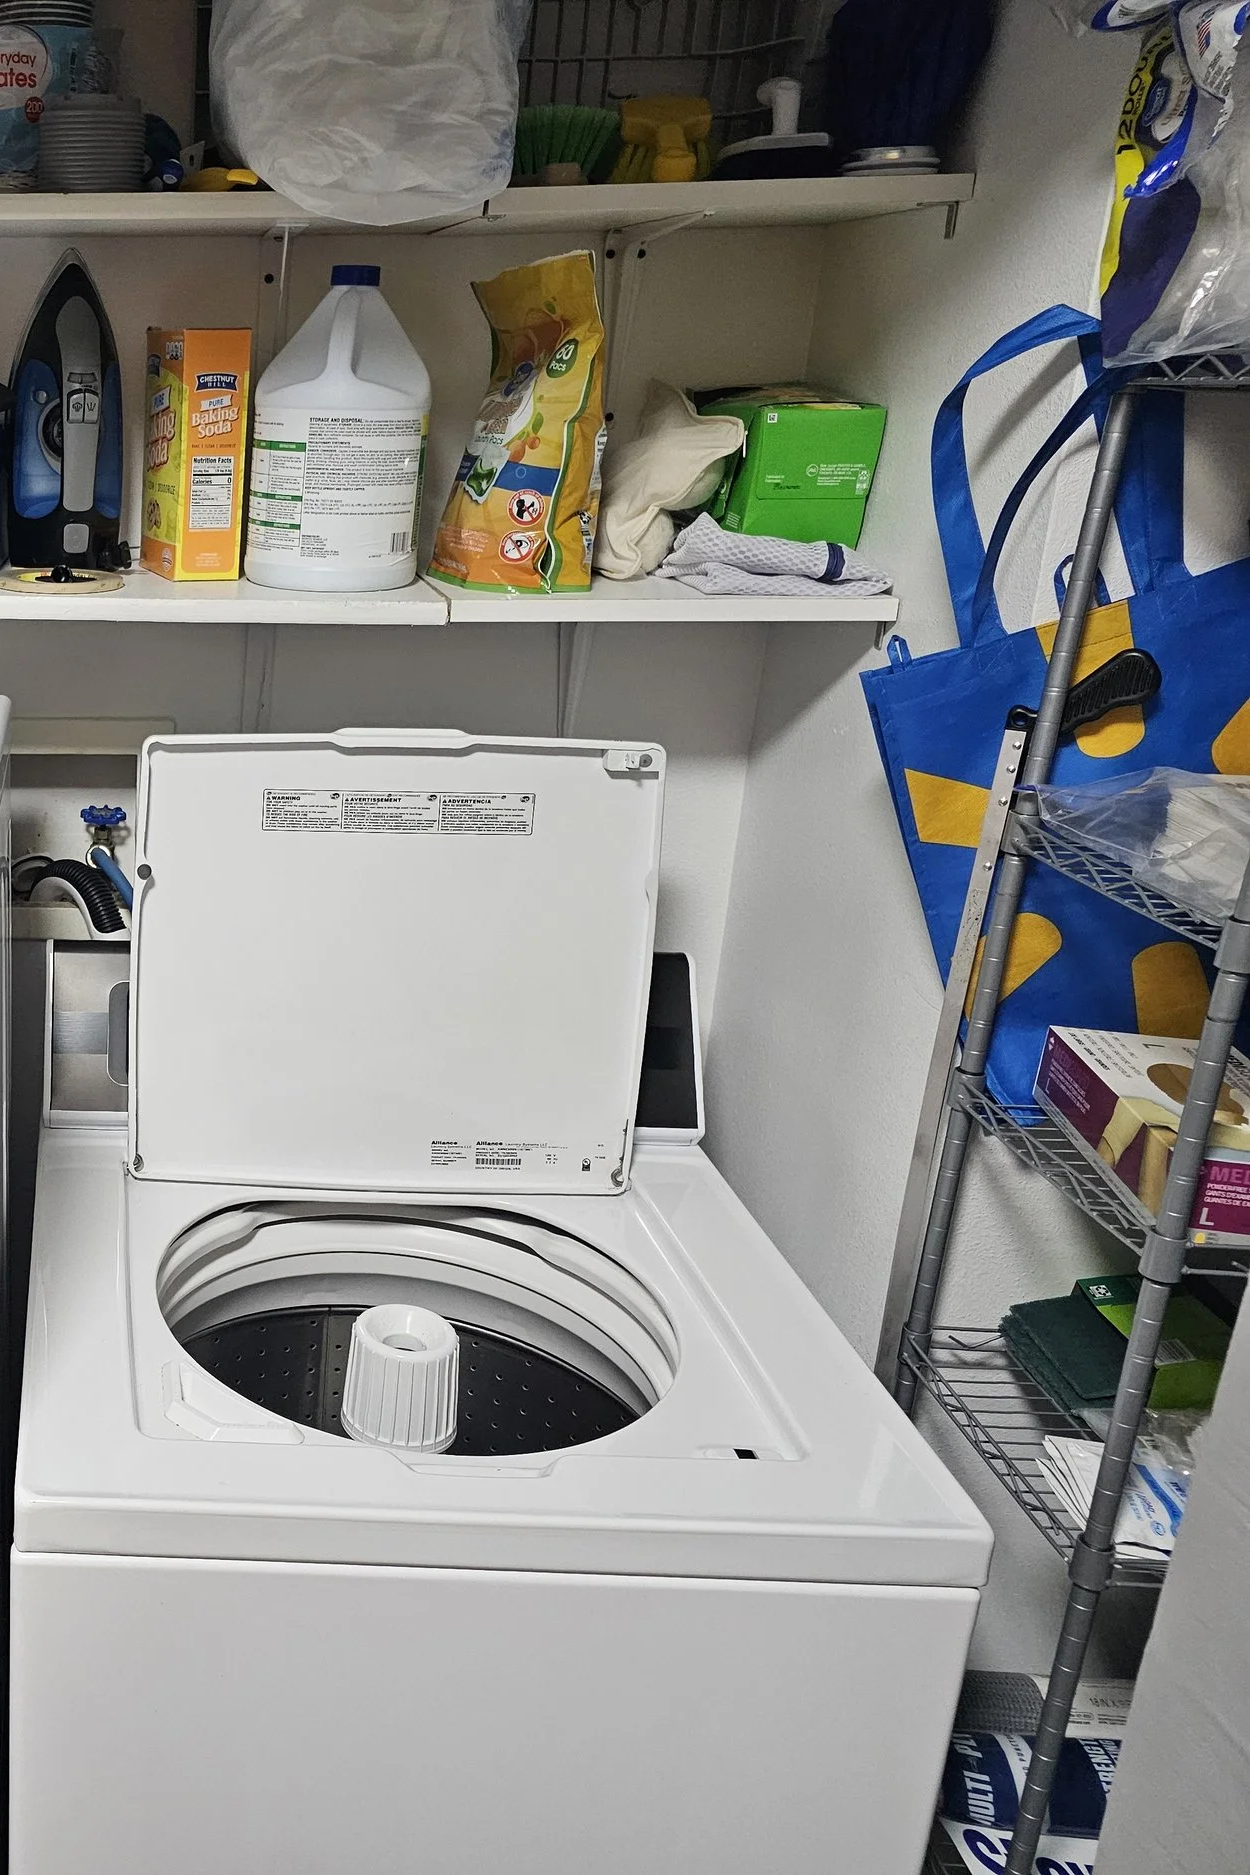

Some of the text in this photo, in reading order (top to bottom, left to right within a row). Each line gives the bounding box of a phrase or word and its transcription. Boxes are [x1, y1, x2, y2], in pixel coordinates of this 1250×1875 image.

[556, 344, 575, 360] 60
[199, 375, 235, 384] CHESTNUT
[208, 398, 224, 408] PURE
[191, 406, 239, 428] Baking
[197, 420, 232, 439] Soda
[1199, 1207, 1214, 1227] L
[1079, 1738, 1116, 1794] TRENGT
